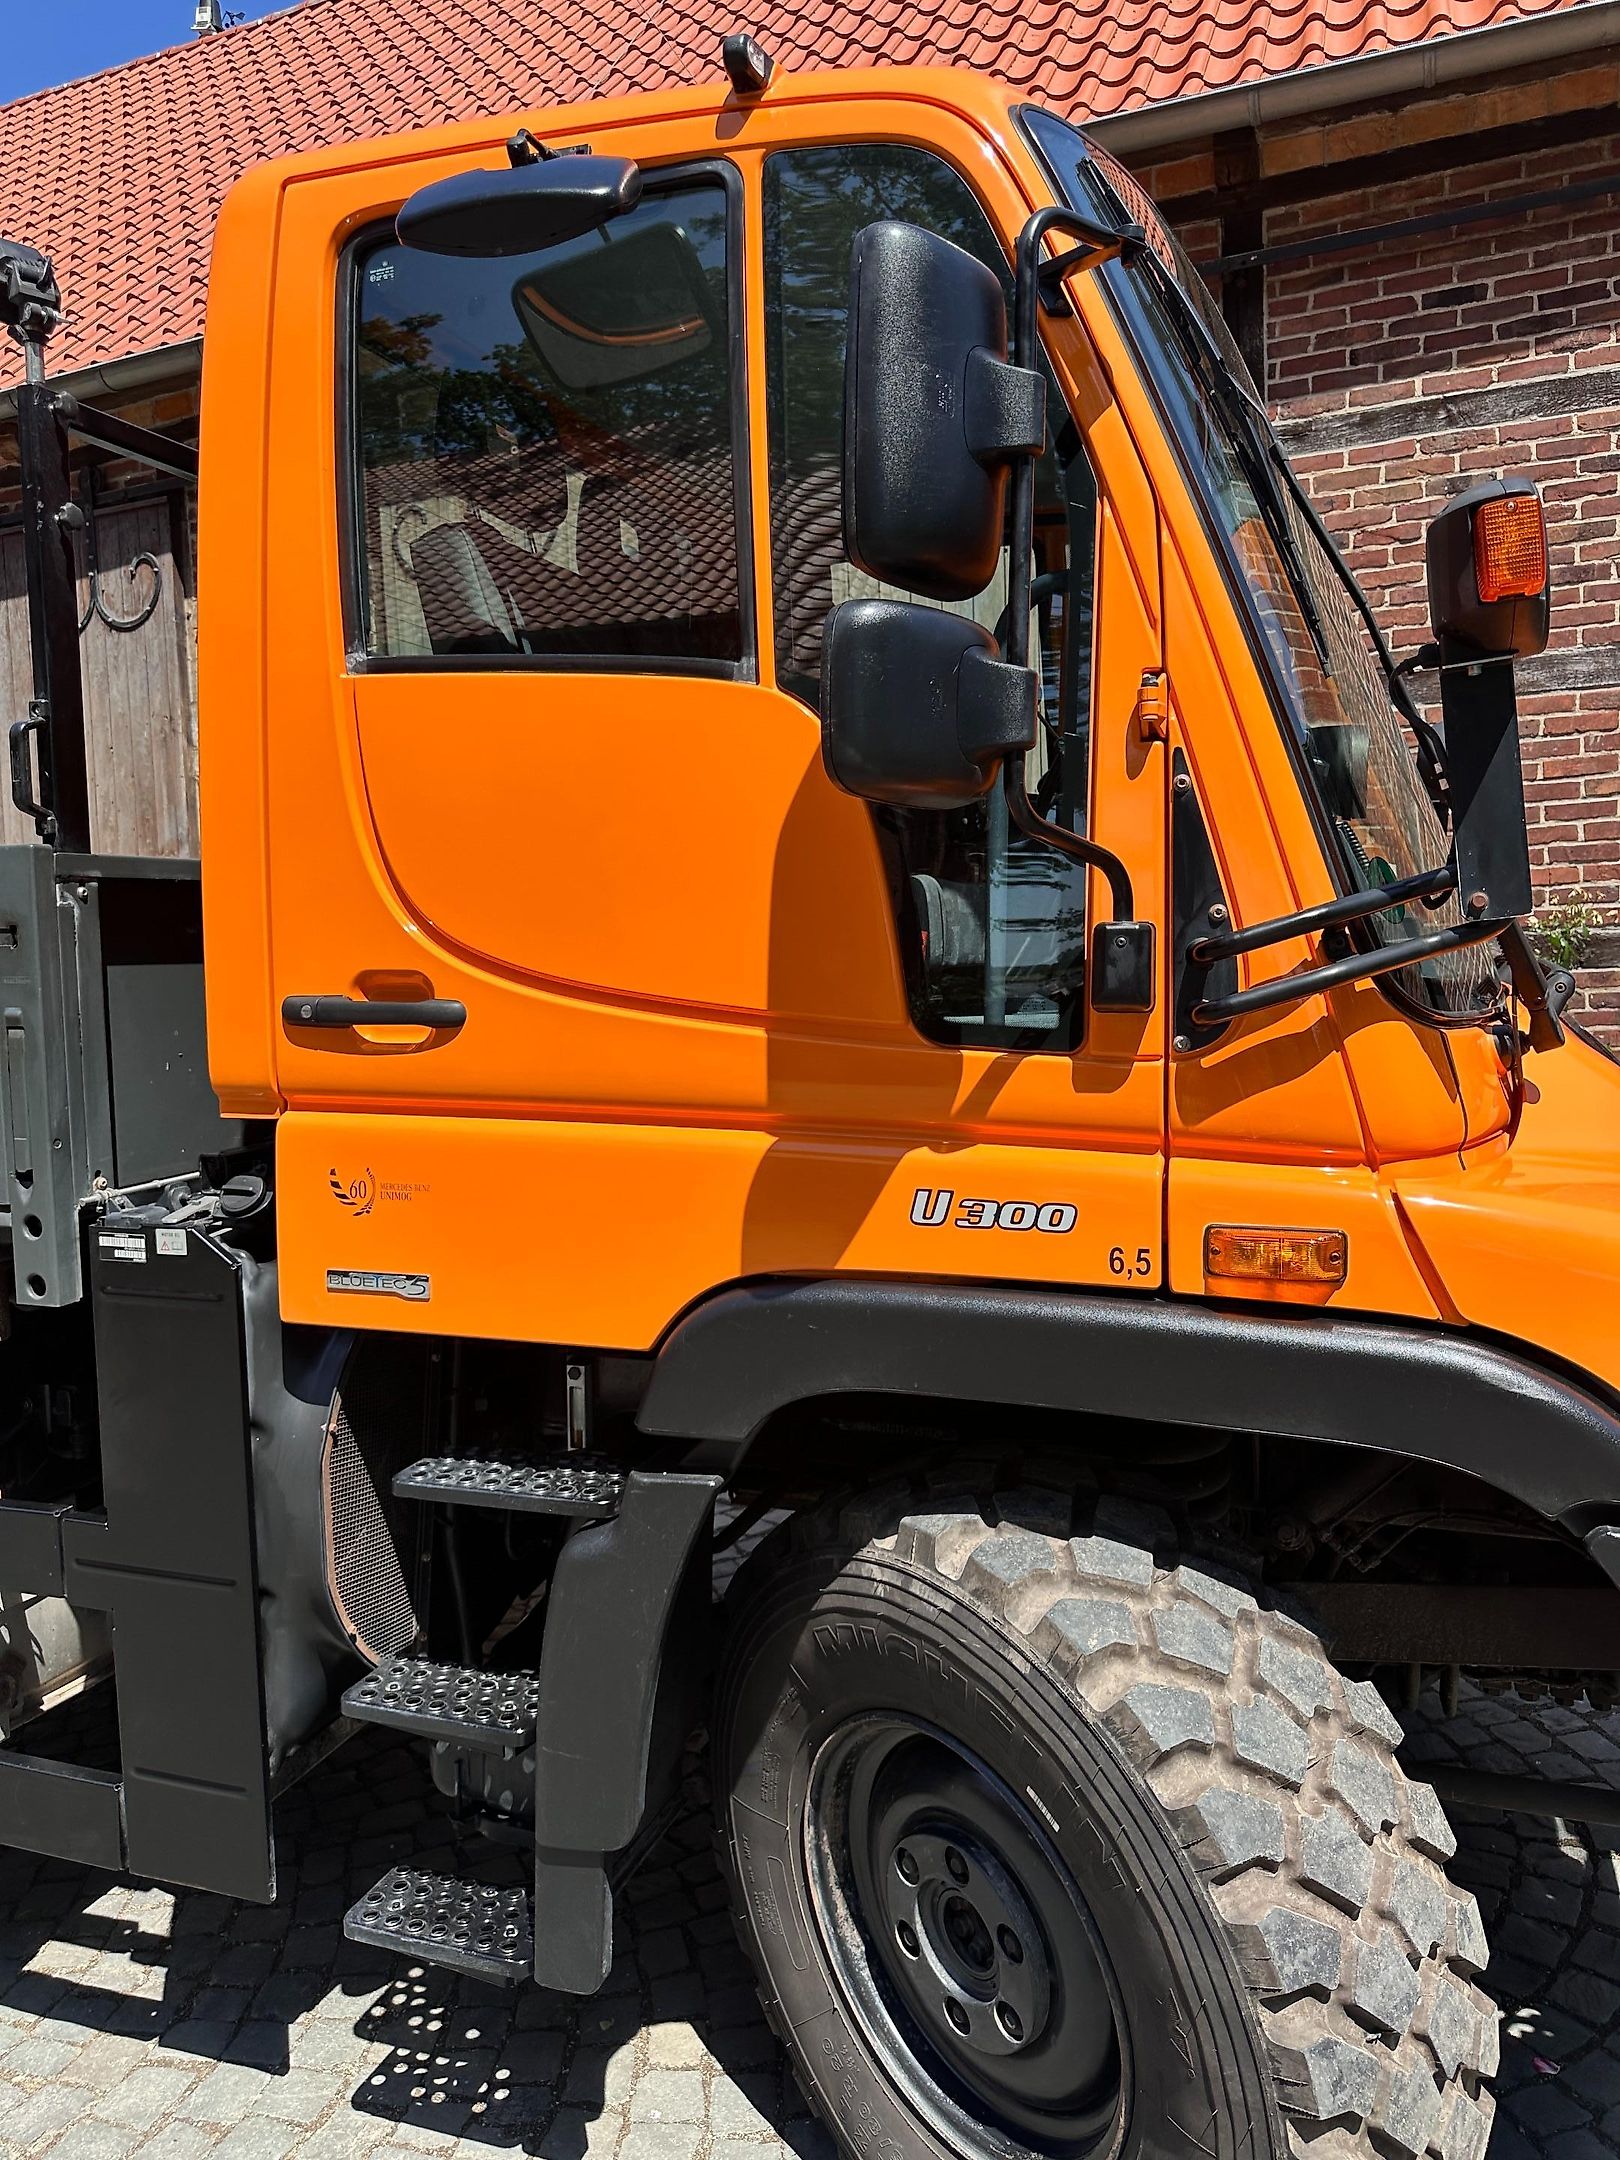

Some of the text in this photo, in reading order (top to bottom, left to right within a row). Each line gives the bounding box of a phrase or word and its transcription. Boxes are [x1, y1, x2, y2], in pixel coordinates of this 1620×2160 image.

[349, 1180, 367, 1199] 60
[380, 1191, 412, 1201] UNIMOG
[910, 1188, 1078, 1233] U 300
[1109, 1246, 1152, 1280] 6,5
